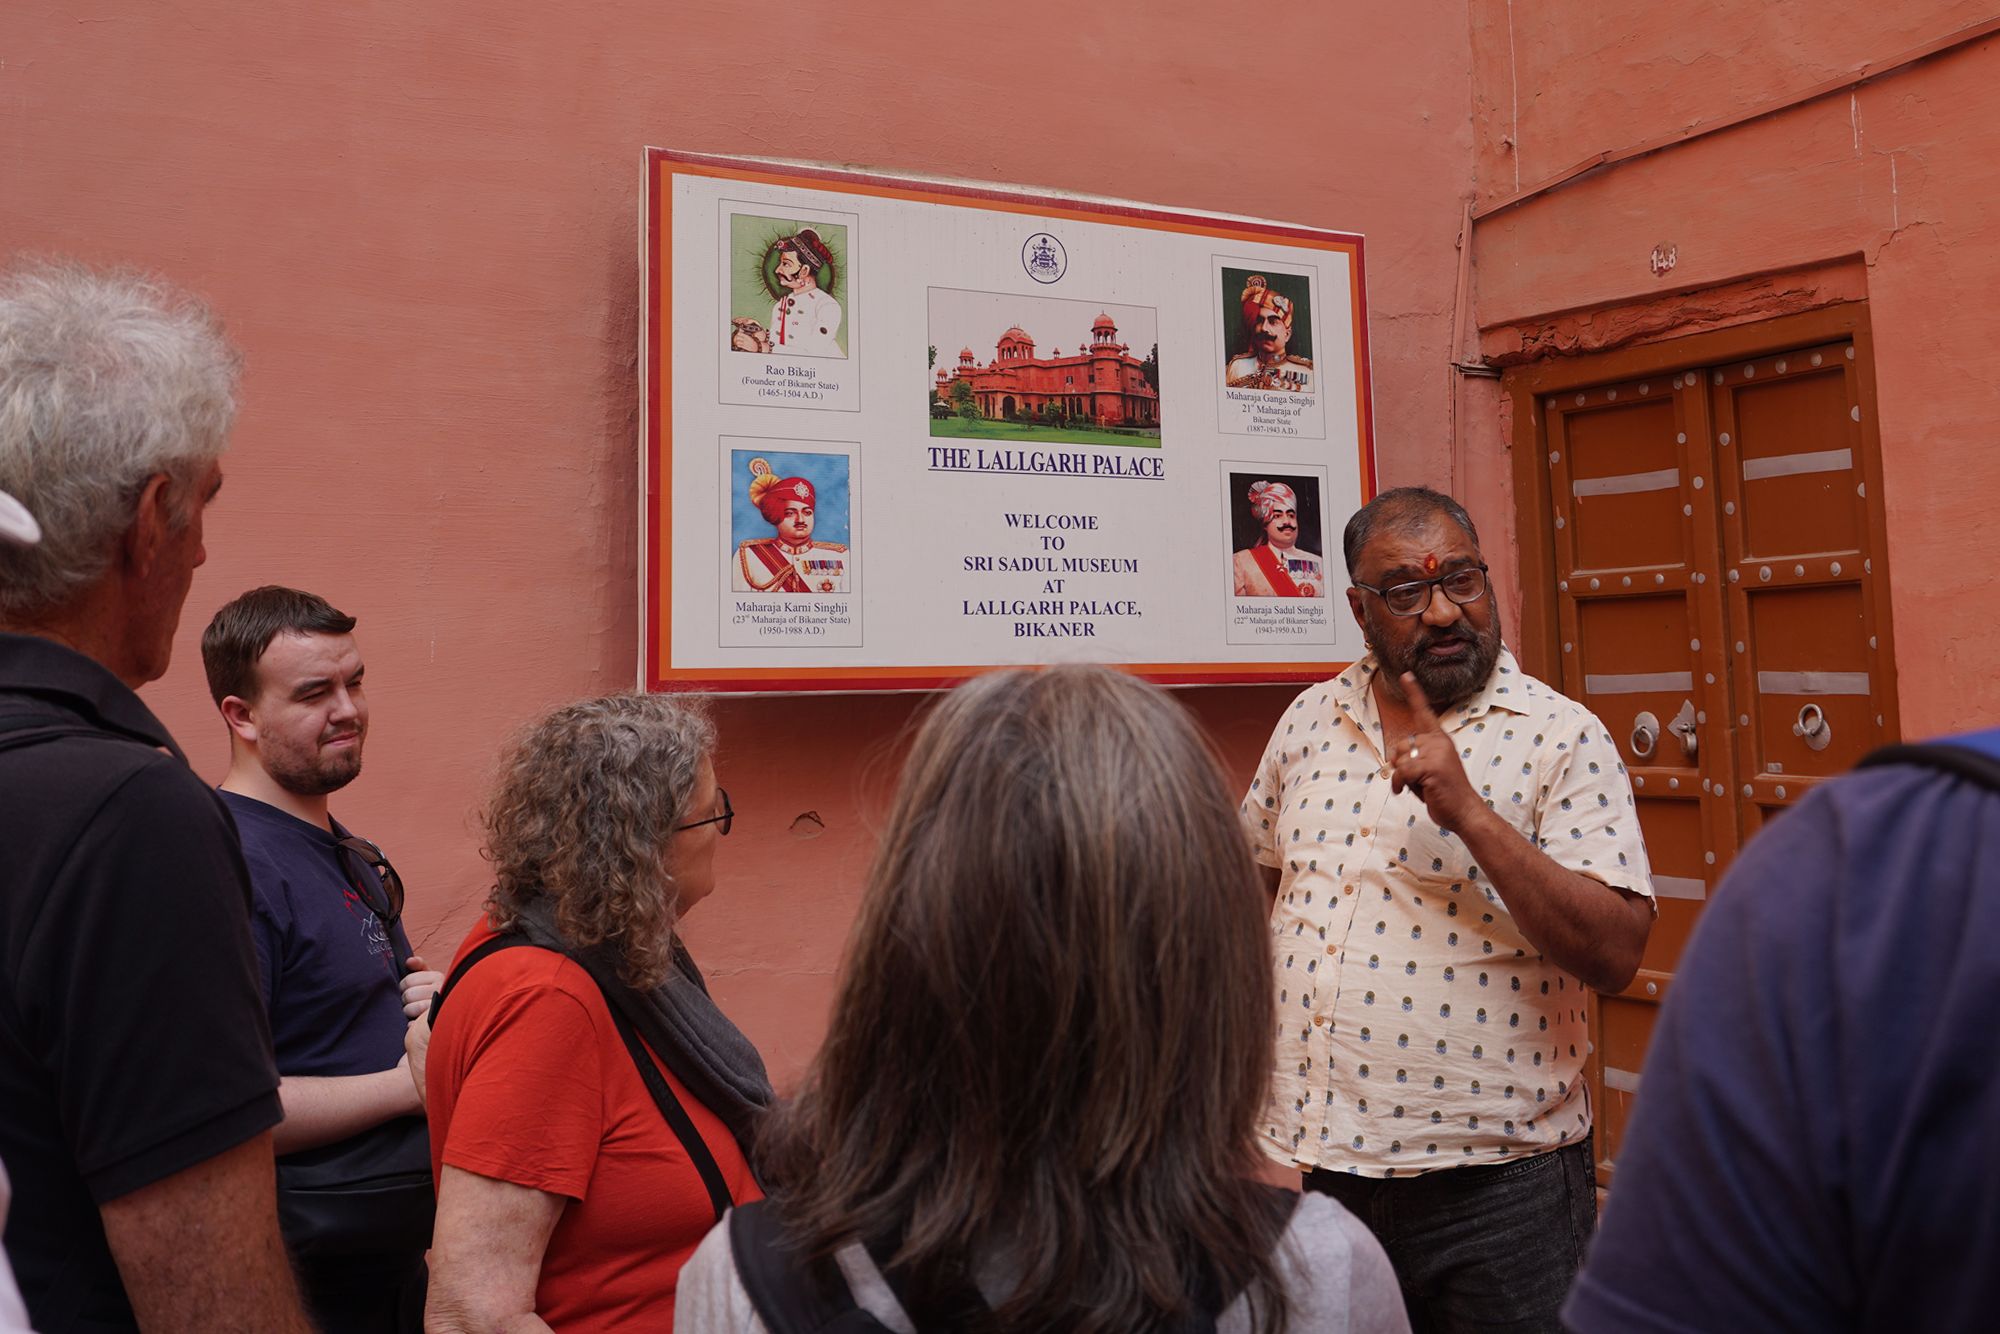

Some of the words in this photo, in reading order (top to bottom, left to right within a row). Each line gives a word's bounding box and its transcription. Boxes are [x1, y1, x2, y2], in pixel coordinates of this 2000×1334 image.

[766, 365, 785, 376] Rao
[787, 366, 816, 380] Bikaji
[742, 376, 776, 387] (Founder
[777, 378, 787, 387] of
[787, 379, 816, 389] Bikaner
[818, 381, 839, 391] State)
[758, 388, 801, 398] (1465-1504
[802, 391, 824, 400] A.D.)
[1226, 391, 1261, 403] Maharaja
[1263, 393, 1288, 405] Ganga
[1289, 395, 1315, 407] Singhji
[1256, 405, 1291, 417] Maharaja
[1293, 407, 1302, 416] of
[1252, 416, 1275, 425] Bikaner
[1277, 417, 1291, 425] State
[928, 447, 971, 469] THE
[977, 449, 1087, 474] LALLGARH
[1092, 454, 1165, 477] PALACE
[1004, 513, 1099, 530] WELCOME
[1040, 536, 1065, 551] TO
[963, 556, 993, 571] SRI
[998, 556, 1058, 572] SADUL
[1062, 557, 1139, 573] MUSEUM
[1042, 579, 1065, 594] AT
[736, 602, 782, 614] Maharaja
[784, 602, 811, 612] Karni
[814, 602, 848, 615] Singhji
[963, 600, 1064, 615] LALLGARH
[1069, 601, 1142, 618] PALACE,
[1236, 605, 1272, 616] Maharaja
[1274, 605, 1295, 614] Sadul
[1297, 605, 1324, 617] Singhji
[752, 616, 787, 626] Maharaja
[788, 616, 798, 624] of
[799, 616, 828, 624] Bikaner
[829, 616, 851, 625] State)
[1249, 617, 1277, 626] Maharaja
[1286, 617, 1309, 625] Bikaner
[1309, 617, 1327, 625] State)
[804, 627, 825, 635] A.D.)
[1014, 622, 1096, 637] BIKANER
[1290, 626, 1307, 635] A.D.)
